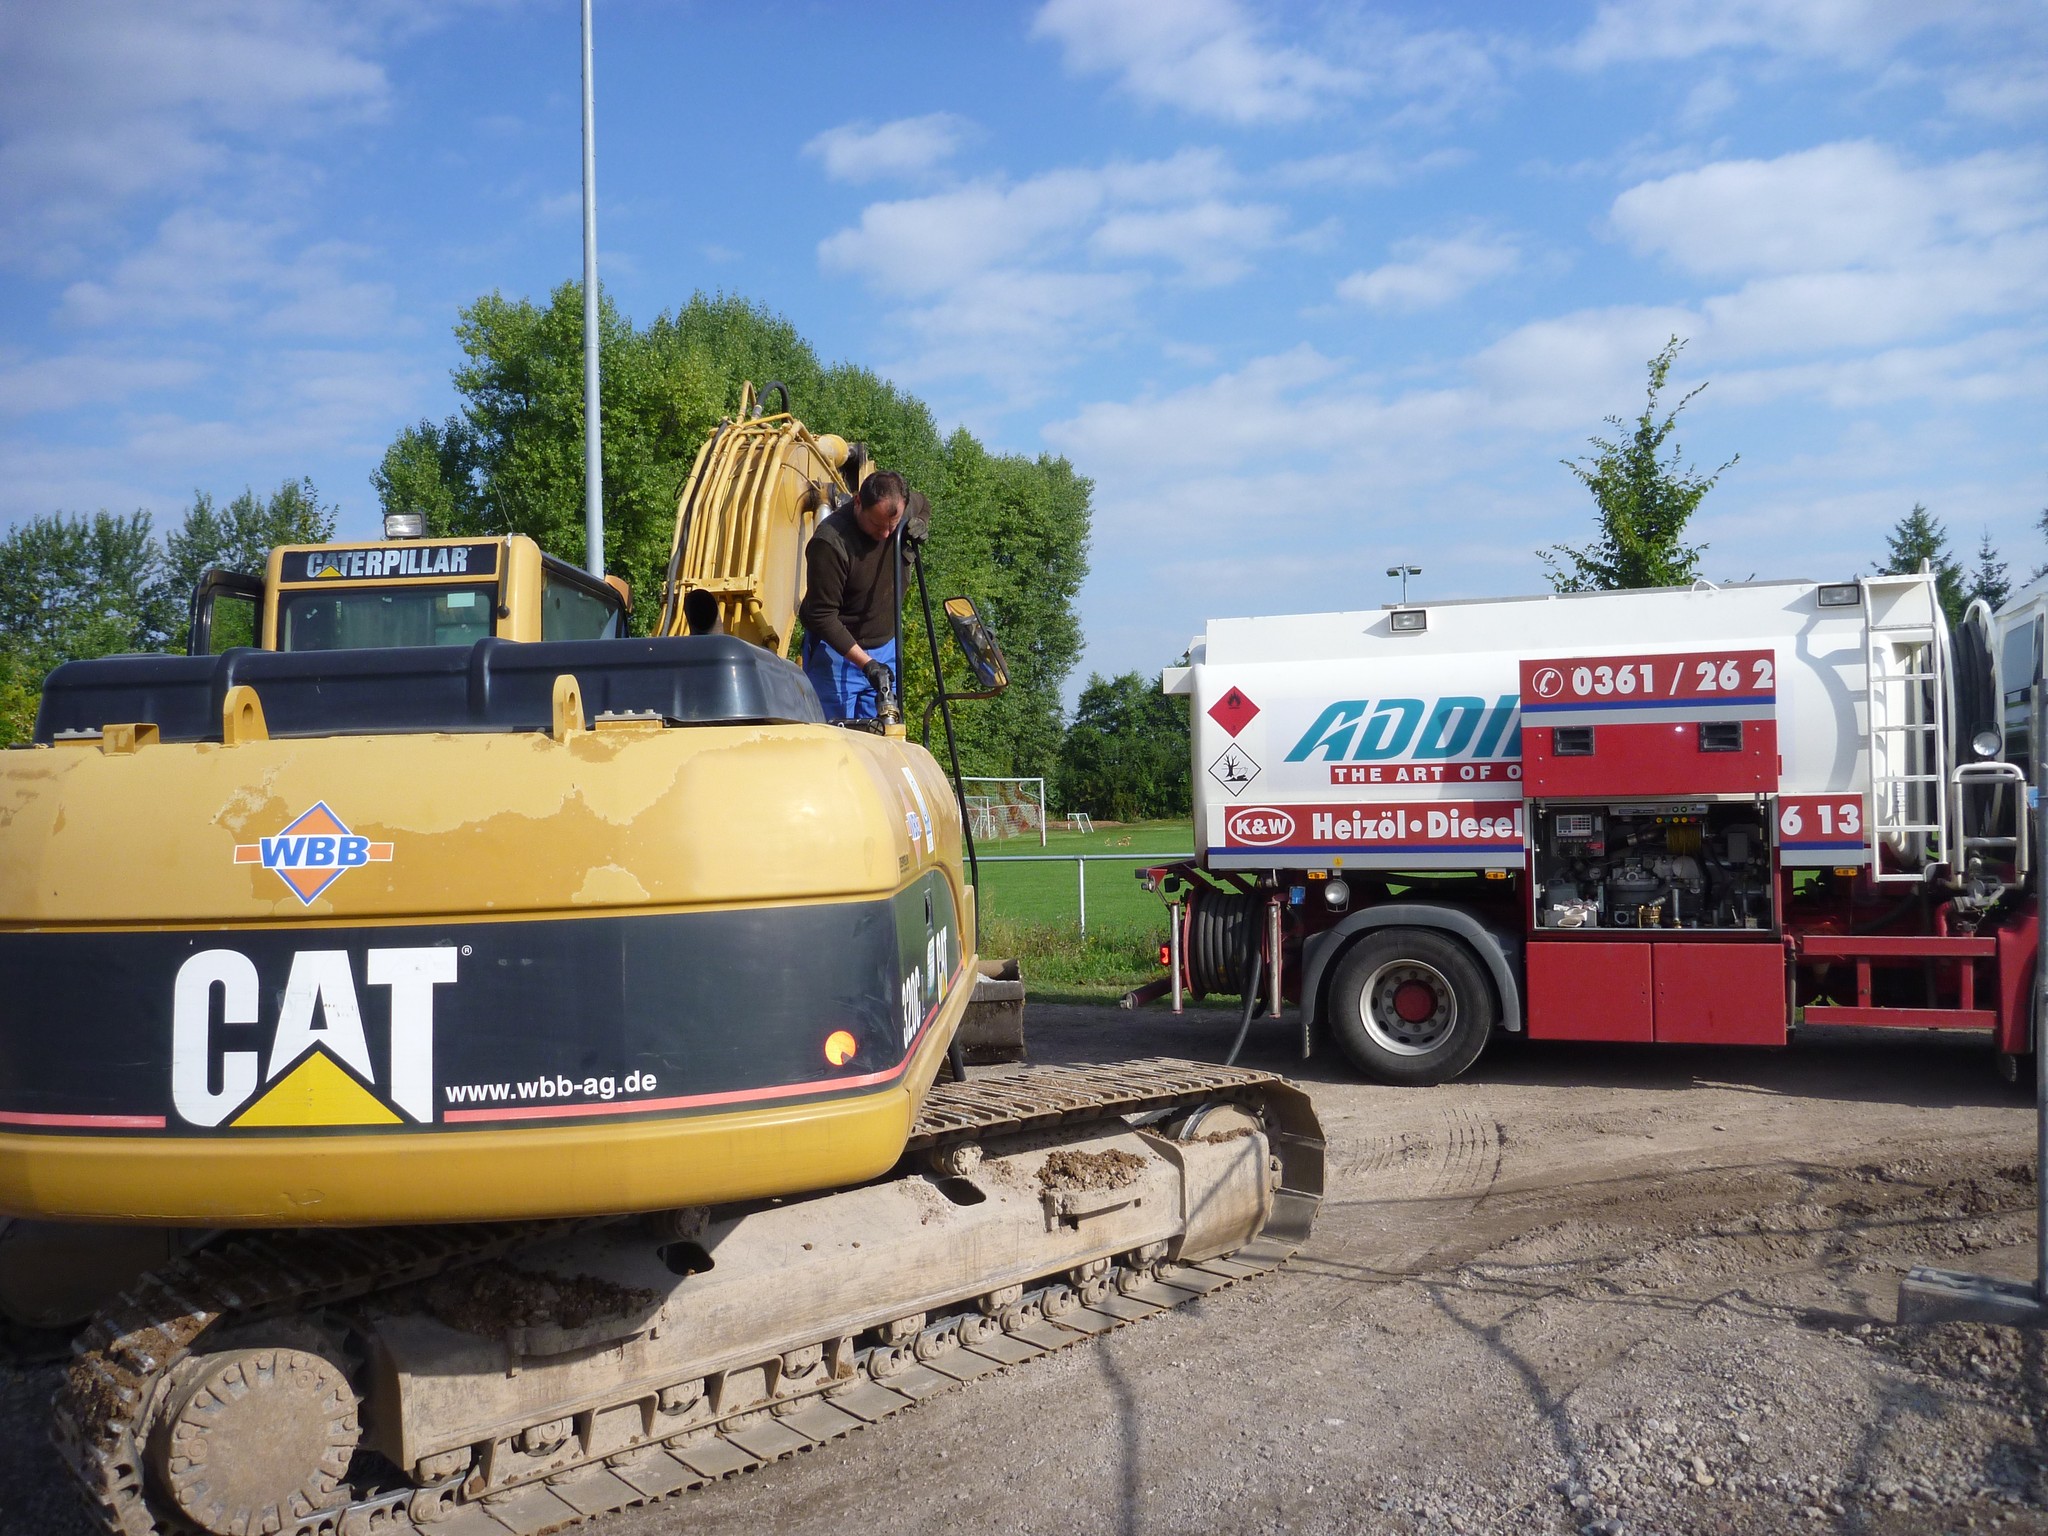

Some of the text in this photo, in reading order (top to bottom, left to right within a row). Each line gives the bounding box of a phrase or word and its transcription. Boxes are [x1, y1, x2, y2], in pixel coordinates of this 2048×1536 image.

[306, 547, 468, 578] CATERPILLAR
[1572, 664, 1654, 696] 0361
[1696, 660, 1740, 691] 26
[1752, 659, 1774, 689] 2
[1335, 767, 1382, 783] THE
[1395, 766, 1444, 782] ART
[1460, 765, 1492, 780] OF
[1236, 818, 1288, 836] K&W
[1312, 808, 1523, 840] Heizöl Diesel
[1780, 803, 1860, 836] 6 13
[260, 835, 370, 870] WBB
[902, 965, 921, 1050] 320C
[173, 947, 458, 1128] CAT
[445, 1070, 657, 1102] www.wbb-ag.de
